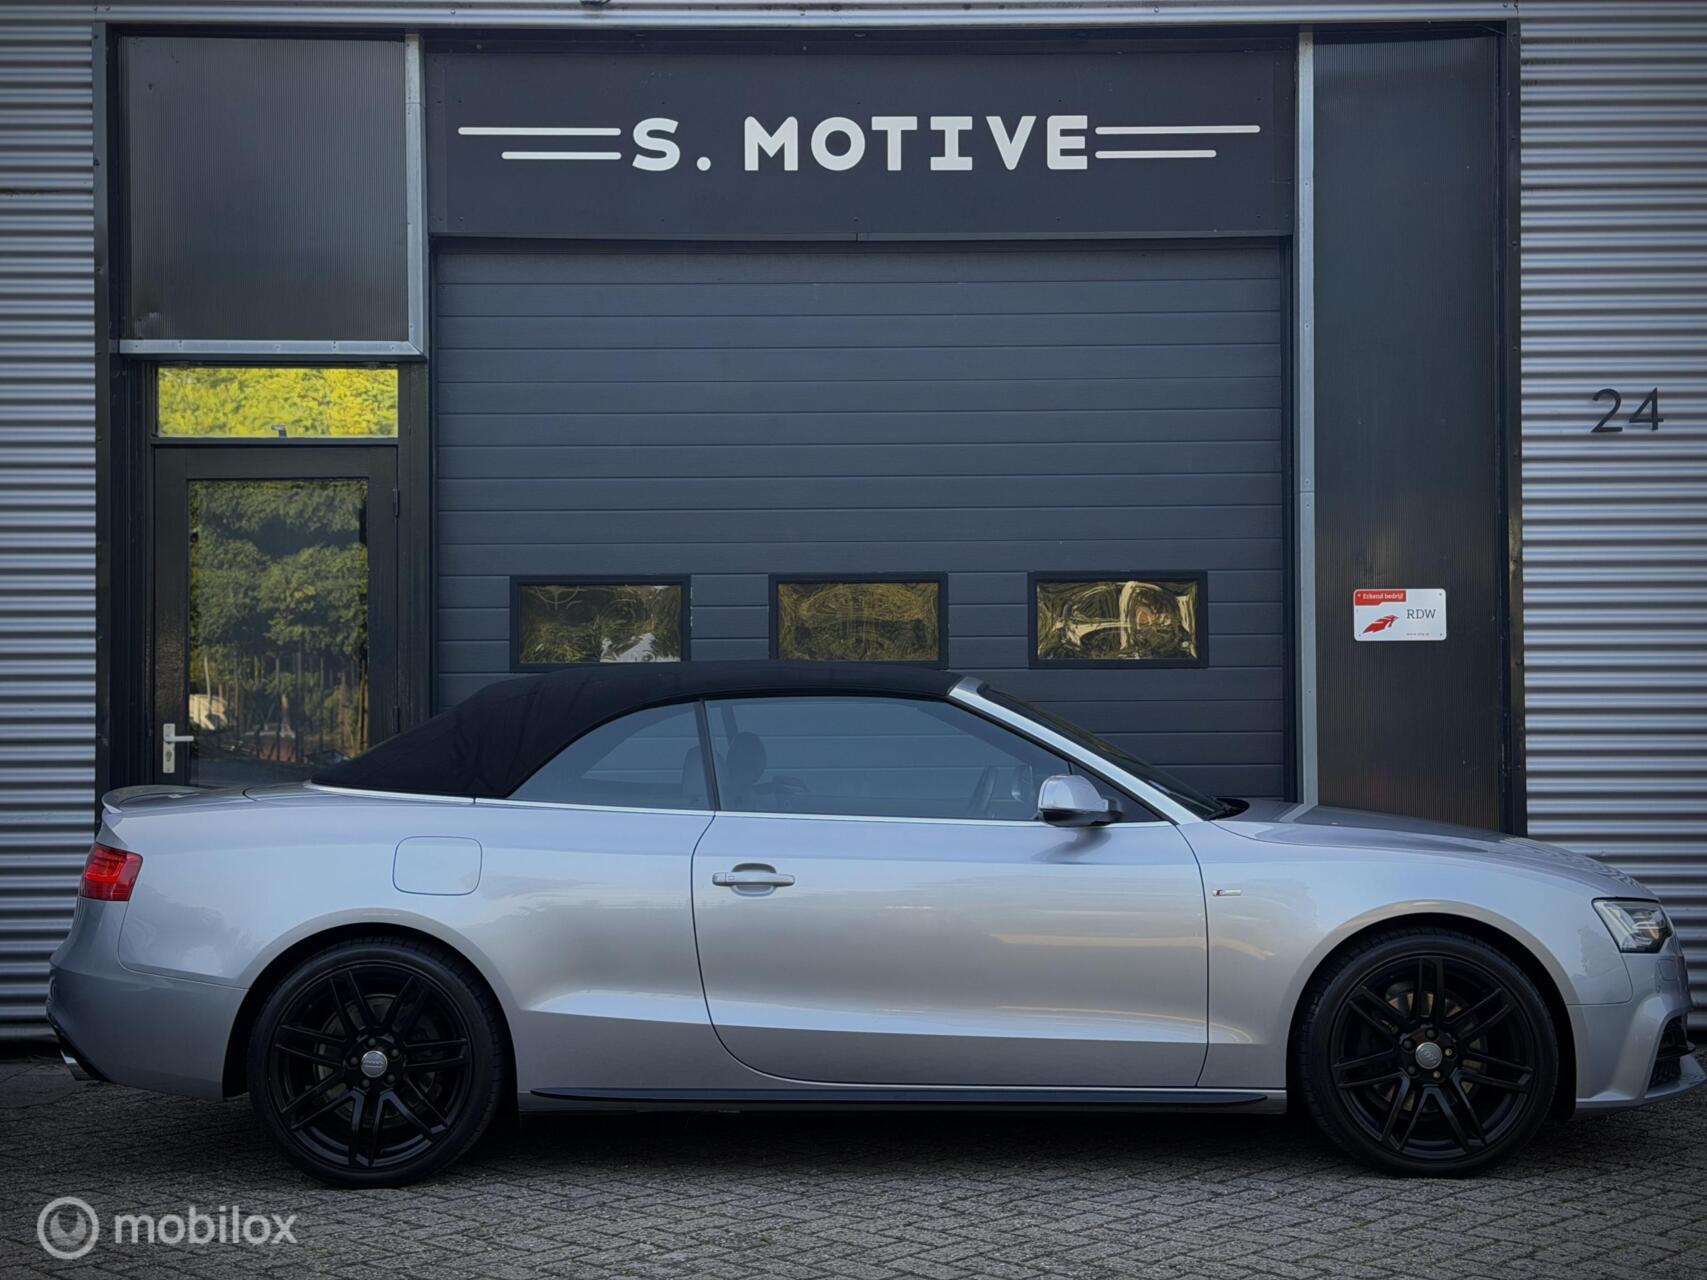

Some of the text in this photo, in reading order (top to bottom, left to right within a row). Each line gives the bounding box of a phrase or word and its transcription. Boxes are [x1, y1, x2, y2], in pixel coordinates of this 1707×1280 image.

[632, 114, 1089, 173] S. MOTIVE
[1590, 387, 1665, 433] 24
[1406, 608, 1436, 619] RDW
